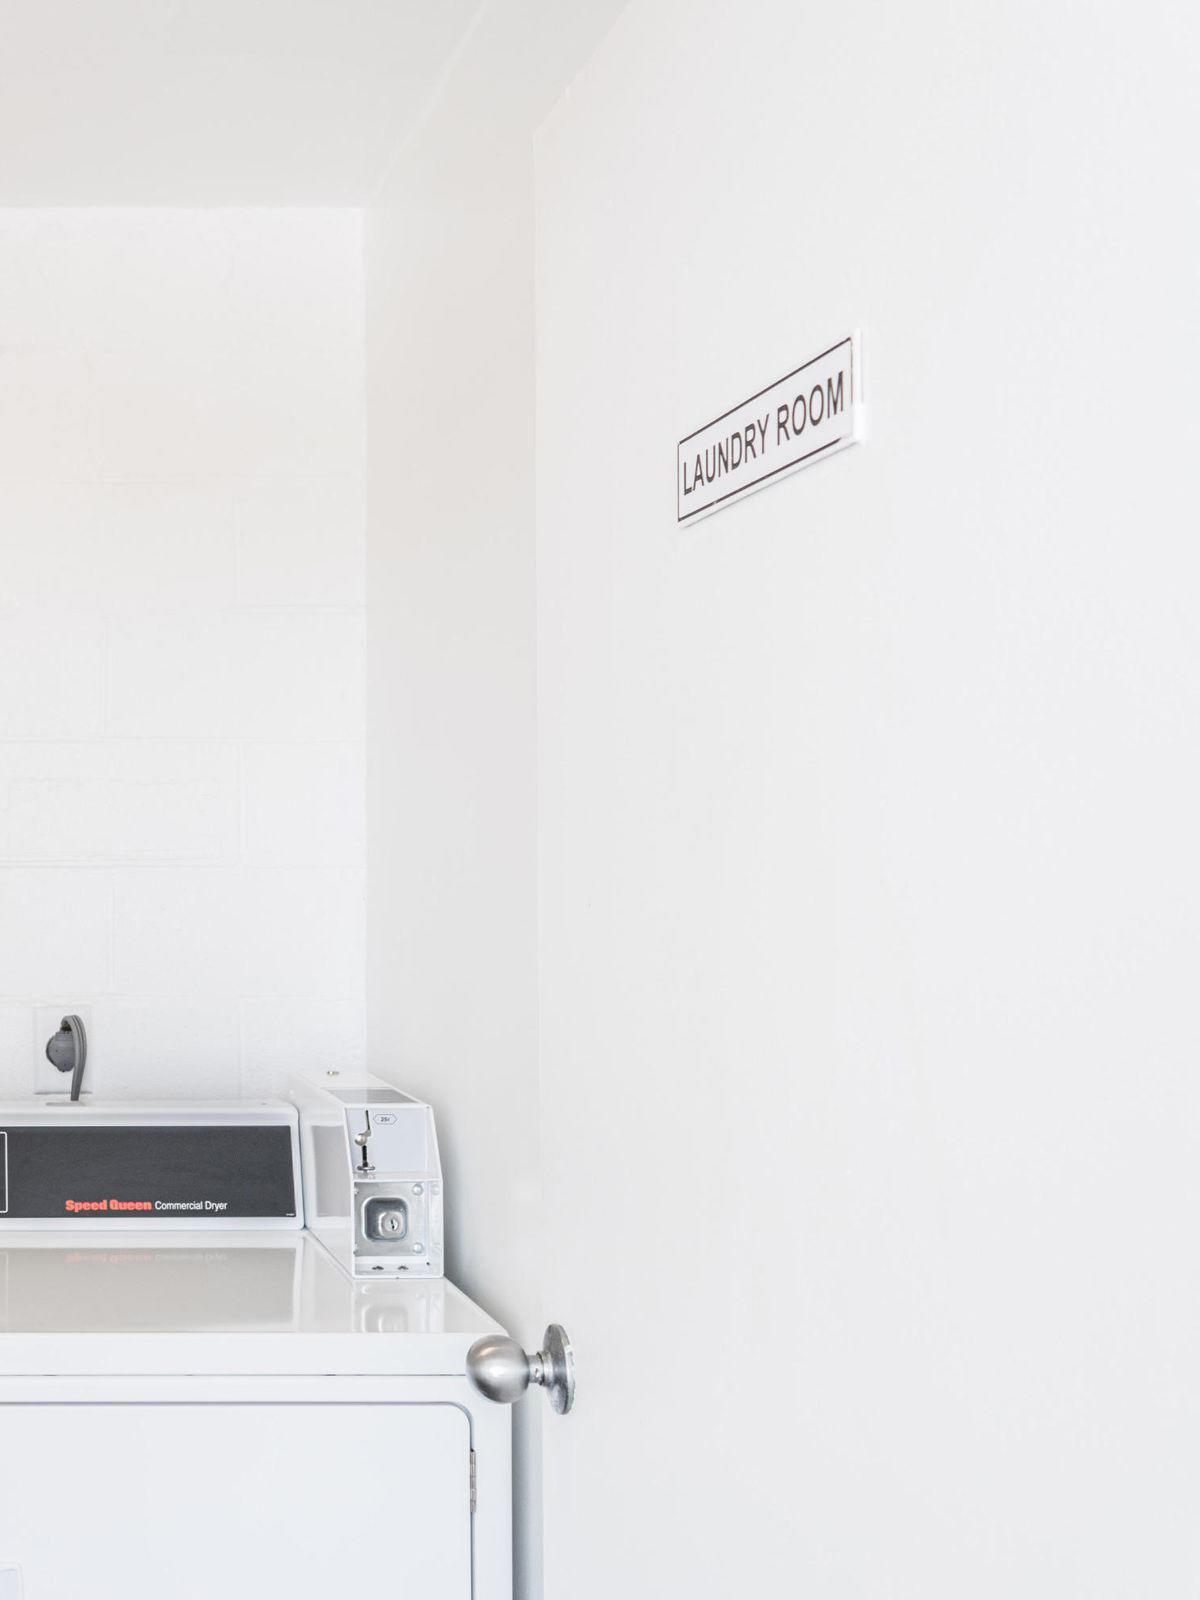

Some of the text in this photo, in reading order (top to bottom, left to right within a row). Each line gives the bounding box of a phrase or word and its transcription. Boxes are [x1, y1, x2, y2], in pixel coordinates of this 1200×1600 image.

[682, 370, 844, 496] LAUNDRY ROOM
[65, 1199, 228, 1212] Speed Queen Commercial Dryer
